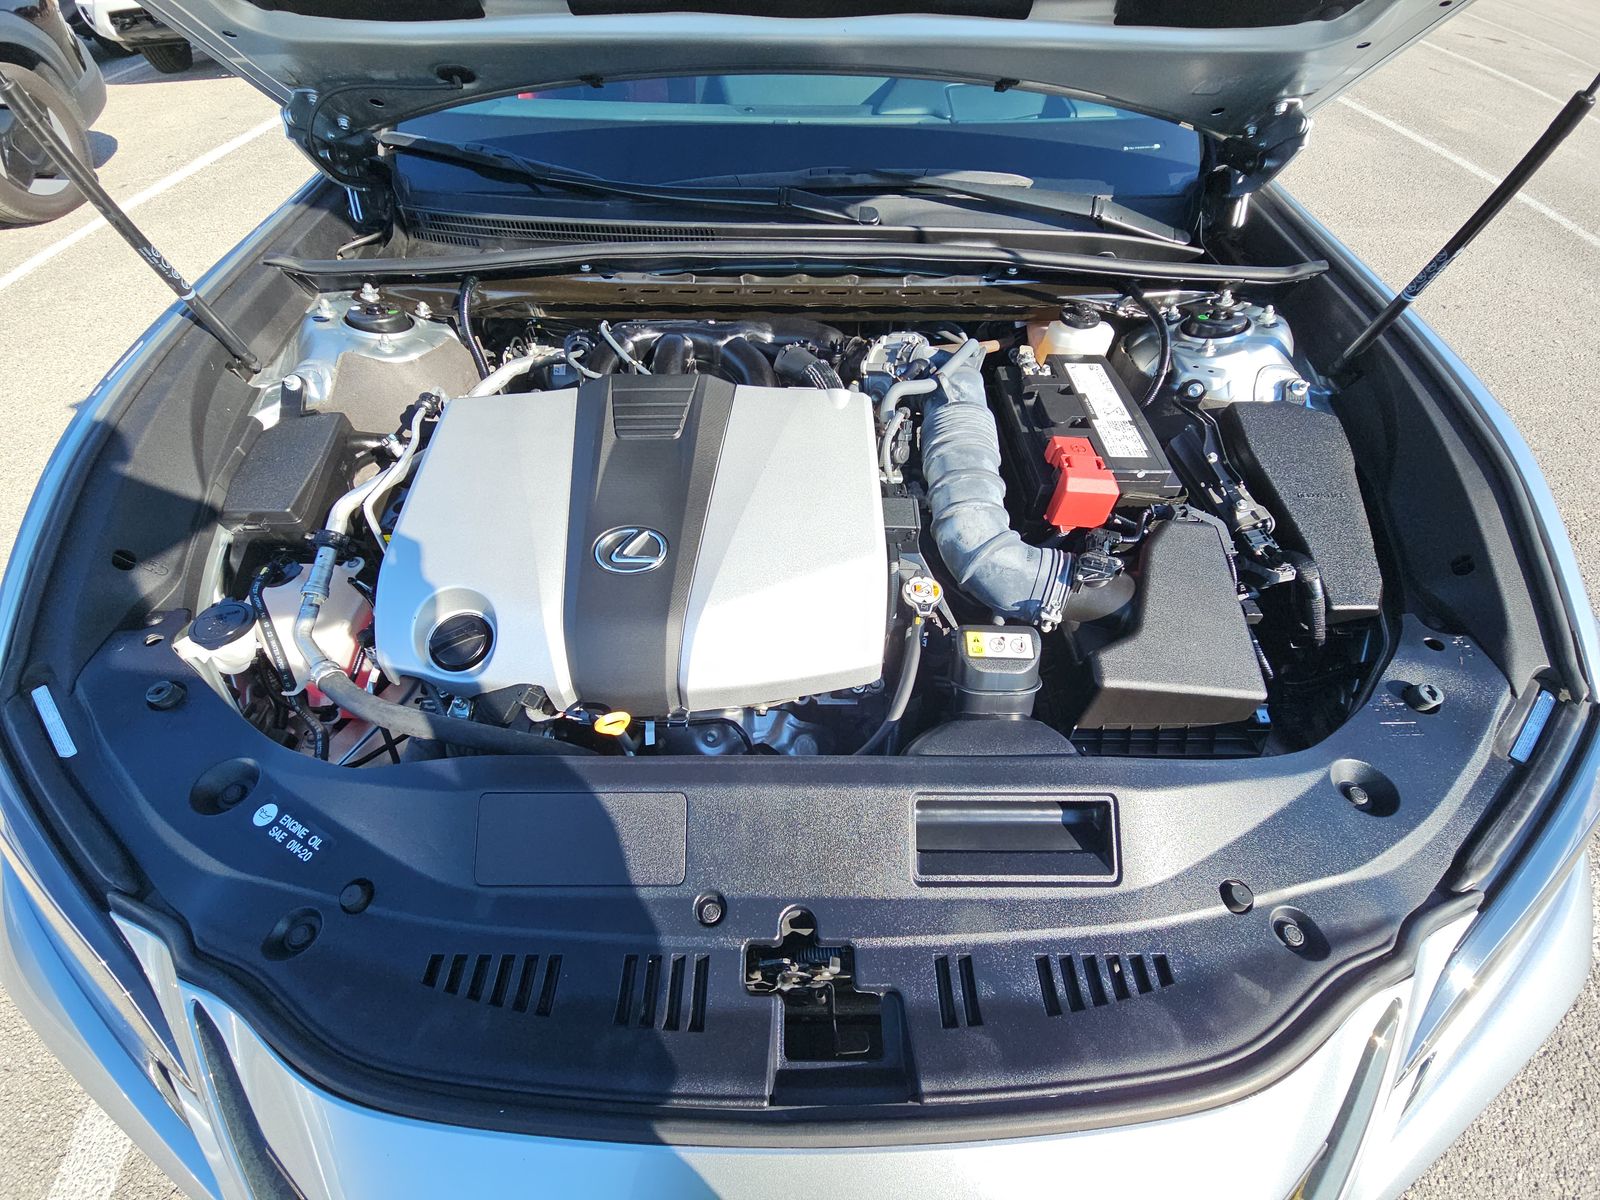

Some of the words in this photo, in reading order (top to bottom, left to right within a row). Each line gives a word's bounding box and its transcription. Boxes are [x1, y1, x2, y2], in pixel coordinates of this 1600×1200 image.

[268, 826, 288, 843] SAE
[286, 839, 313, 862] 0W-20
[279, 814, 310, 839] ENGINE
[307, 835, 323, 851] OIL
